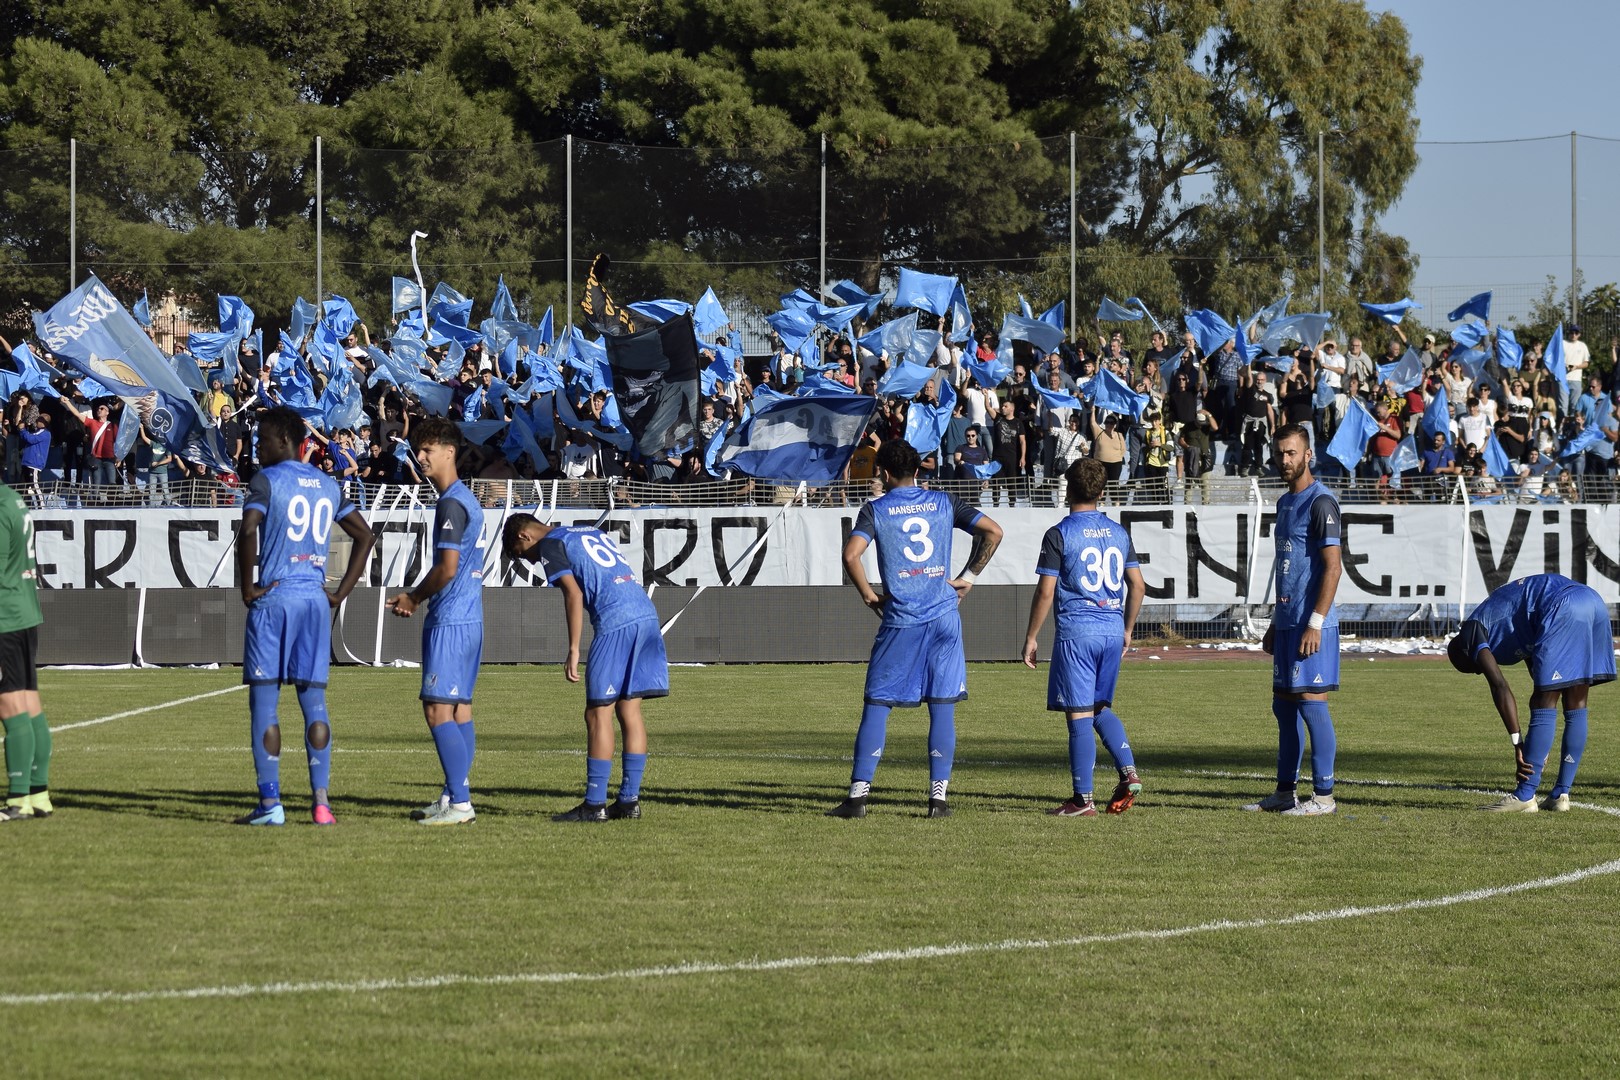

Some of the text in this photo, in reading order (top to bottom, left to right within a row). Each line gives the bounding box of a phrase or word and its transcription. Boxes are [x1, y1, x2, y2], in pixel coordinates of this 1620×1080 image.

[286, 494, 333, 545] 90
[888, 502, 937, 516] MANSERVIGI
[902, 517, 934, 562] 3
[1083, 528, 1112, 538] GIGANTE
[1080, 546, 1124, 592] 30
